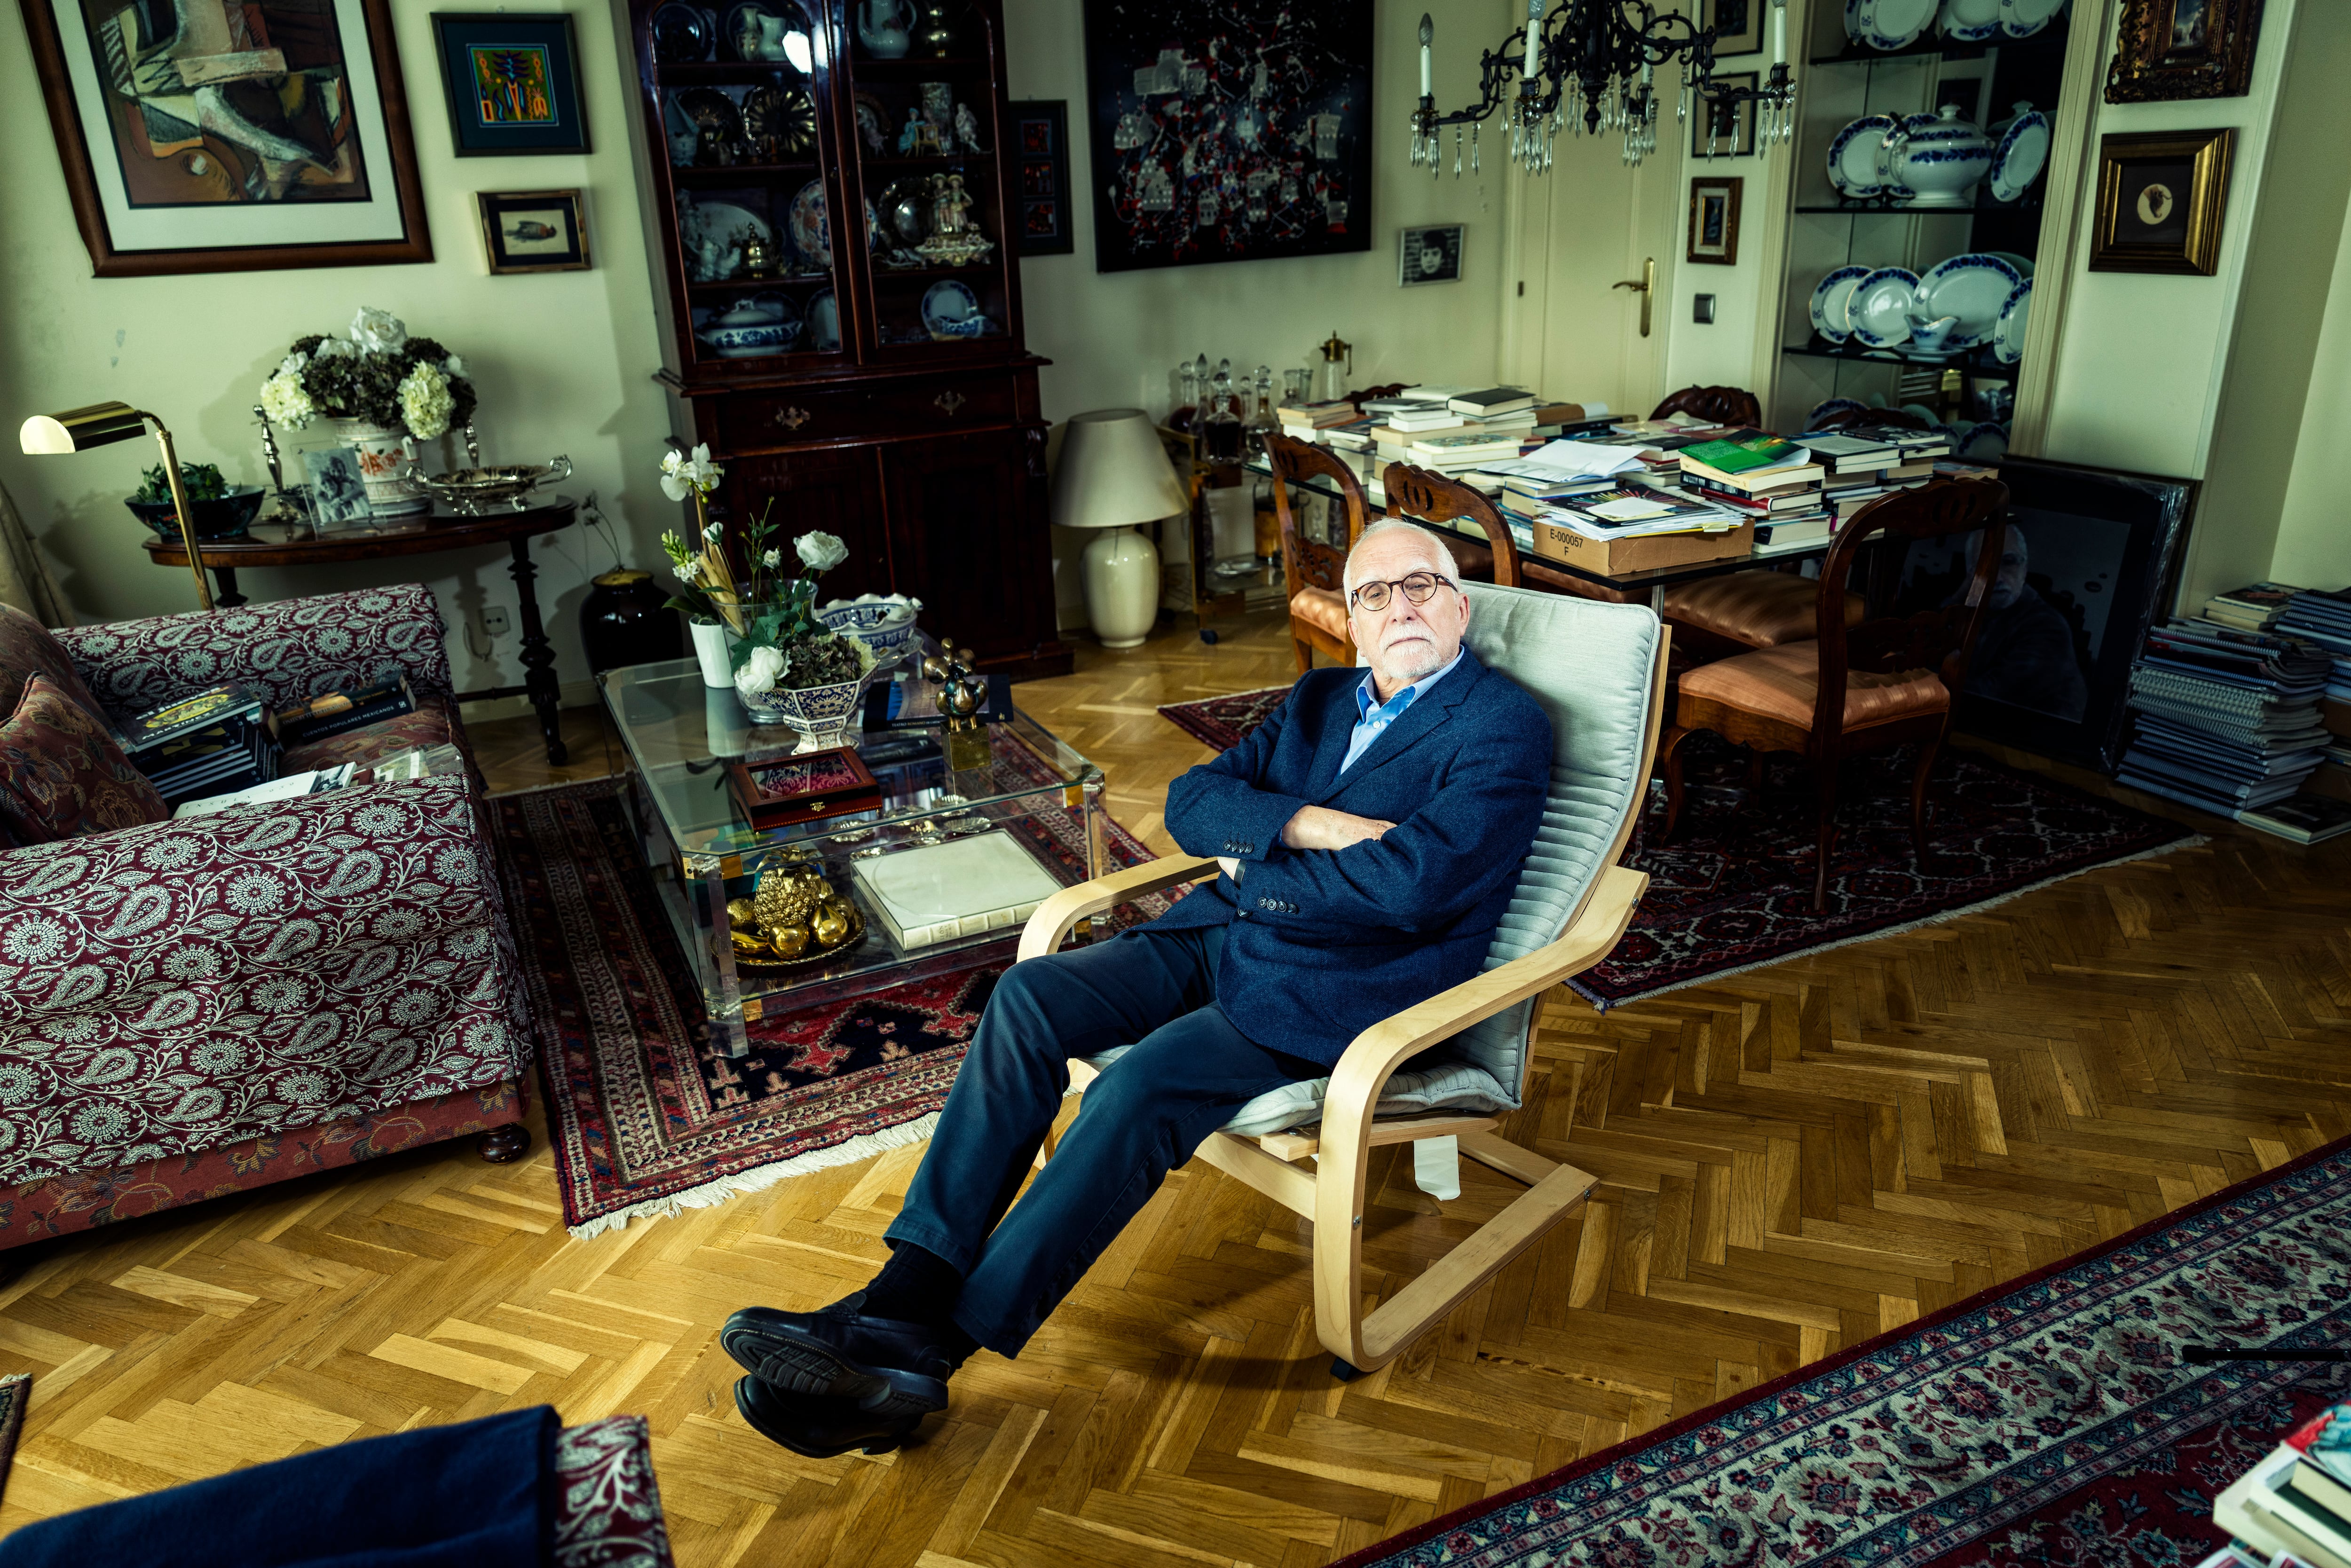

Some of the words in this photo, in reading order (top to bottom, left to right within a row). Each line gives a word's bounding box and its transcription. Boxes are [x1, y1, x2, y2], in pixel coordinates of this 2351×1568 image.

[1550, 528, 1583, 548] E-000057
[1564, 546, 1569, 556] F
[302, 726, 328, 738] CUENTOS
[330, 716, 361, 729] POPULARES
[363, 705, 394, 718] MEXICANOS
